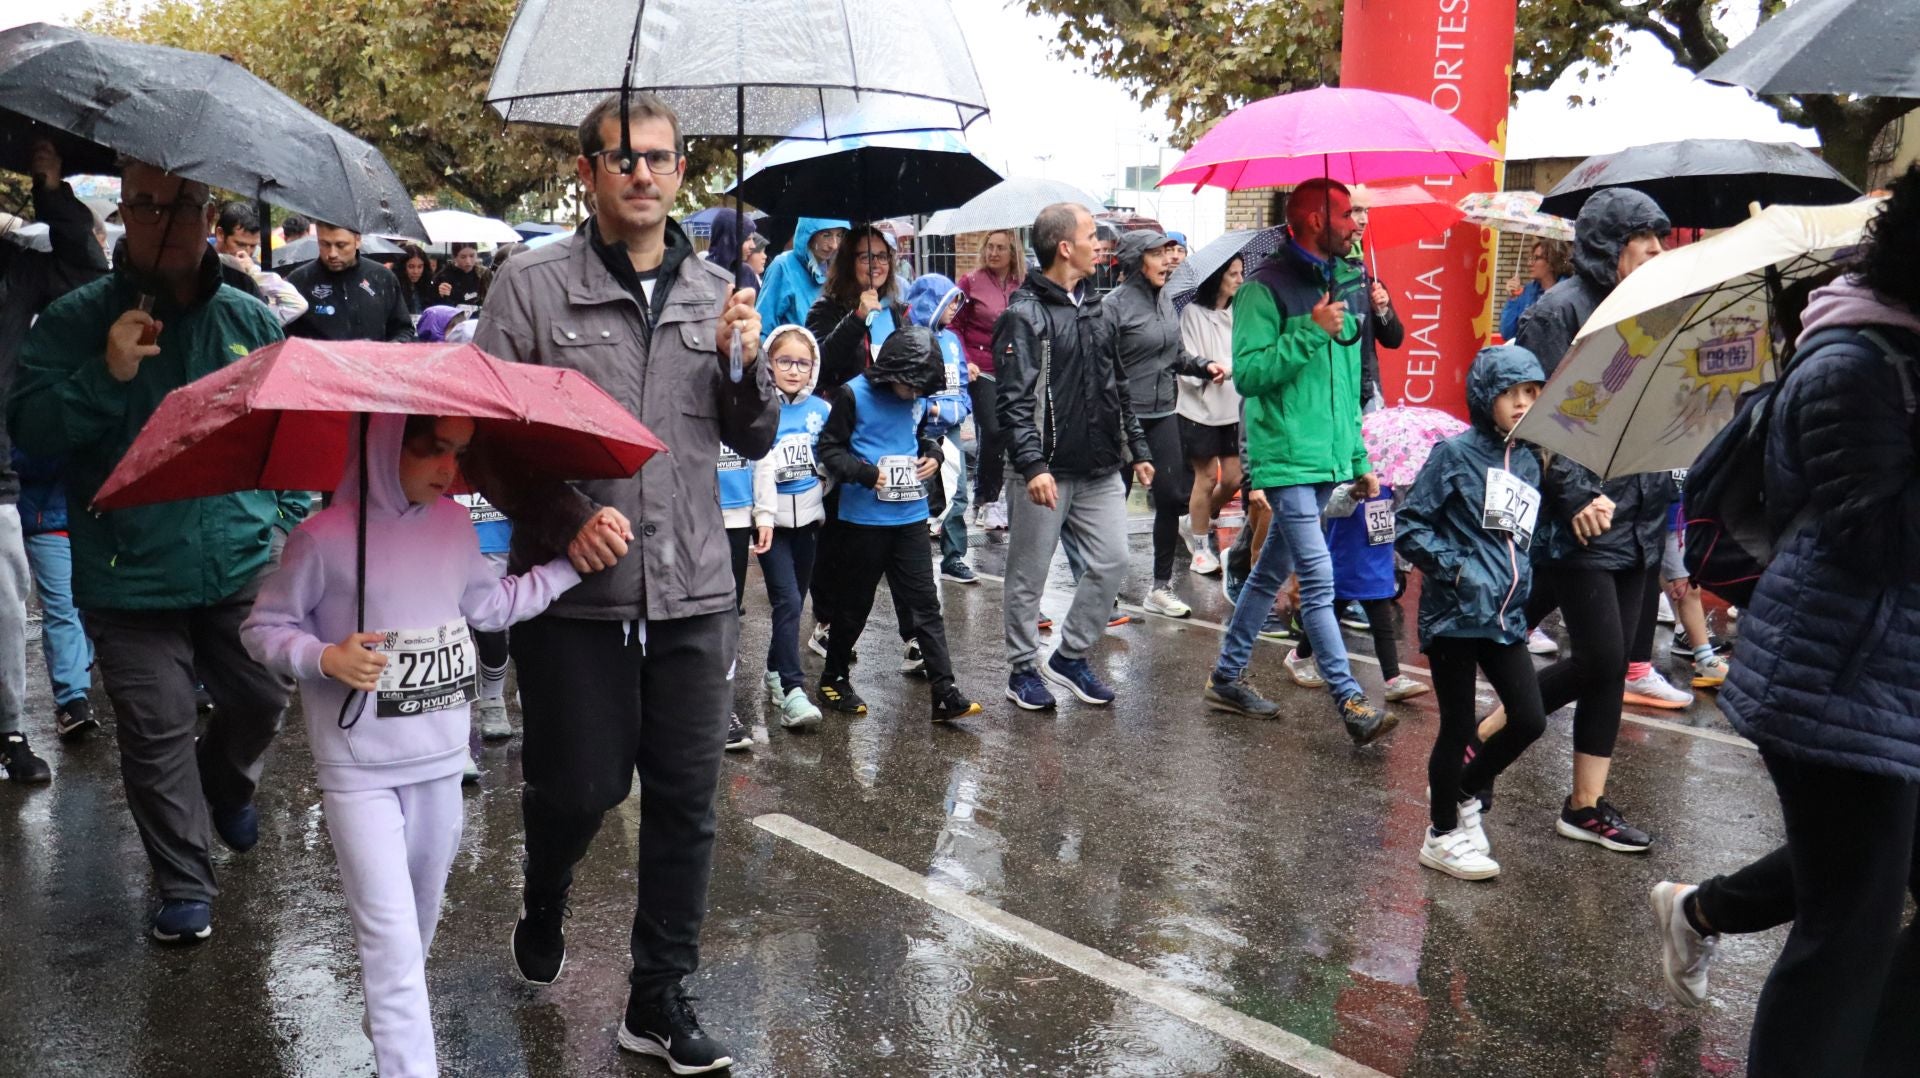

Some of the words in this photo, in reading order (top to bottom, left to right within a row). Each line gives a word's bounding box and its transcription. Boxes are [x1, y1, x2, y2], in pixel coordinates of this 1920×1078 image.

[1404, 266, 1444, 403] CEJALÍA
[783, 444, 808, 465] 1249
[398, 642, 465, 688] 2203
